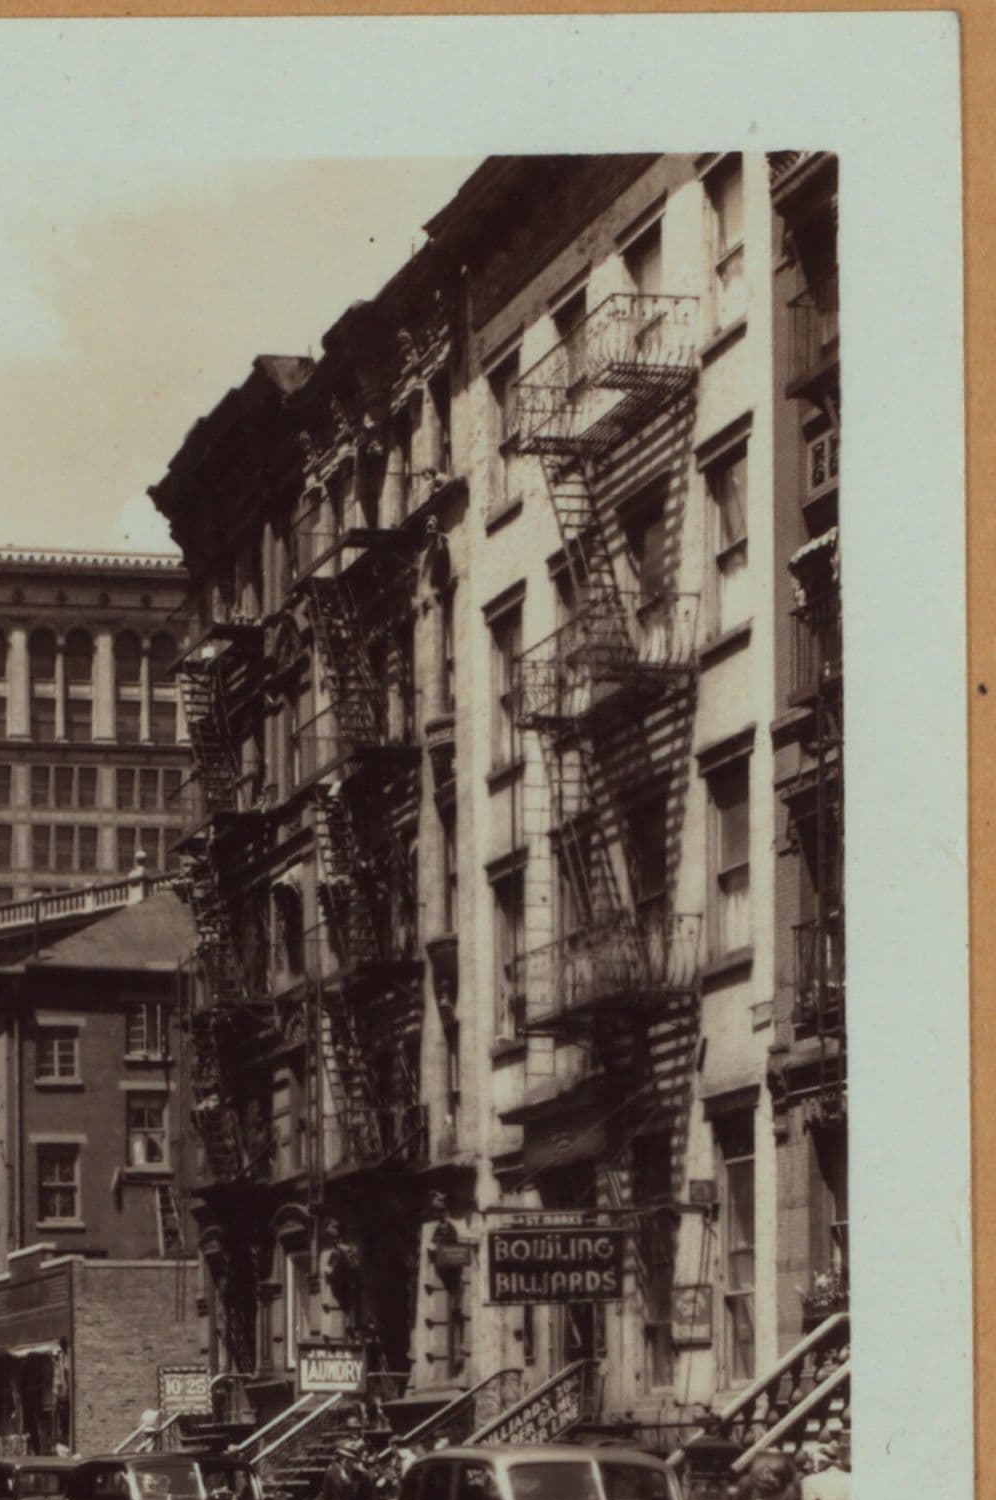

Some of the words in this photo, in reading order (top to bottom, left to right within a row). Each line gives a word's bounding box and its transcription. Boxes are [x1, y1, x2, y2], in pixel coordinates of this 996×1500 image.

[494, 1236, 615, 1261] BOWLING
[495, 1269, 617, 1297] BILLIARDS
[301, 1359, 364, 1390] LAUNDRY
